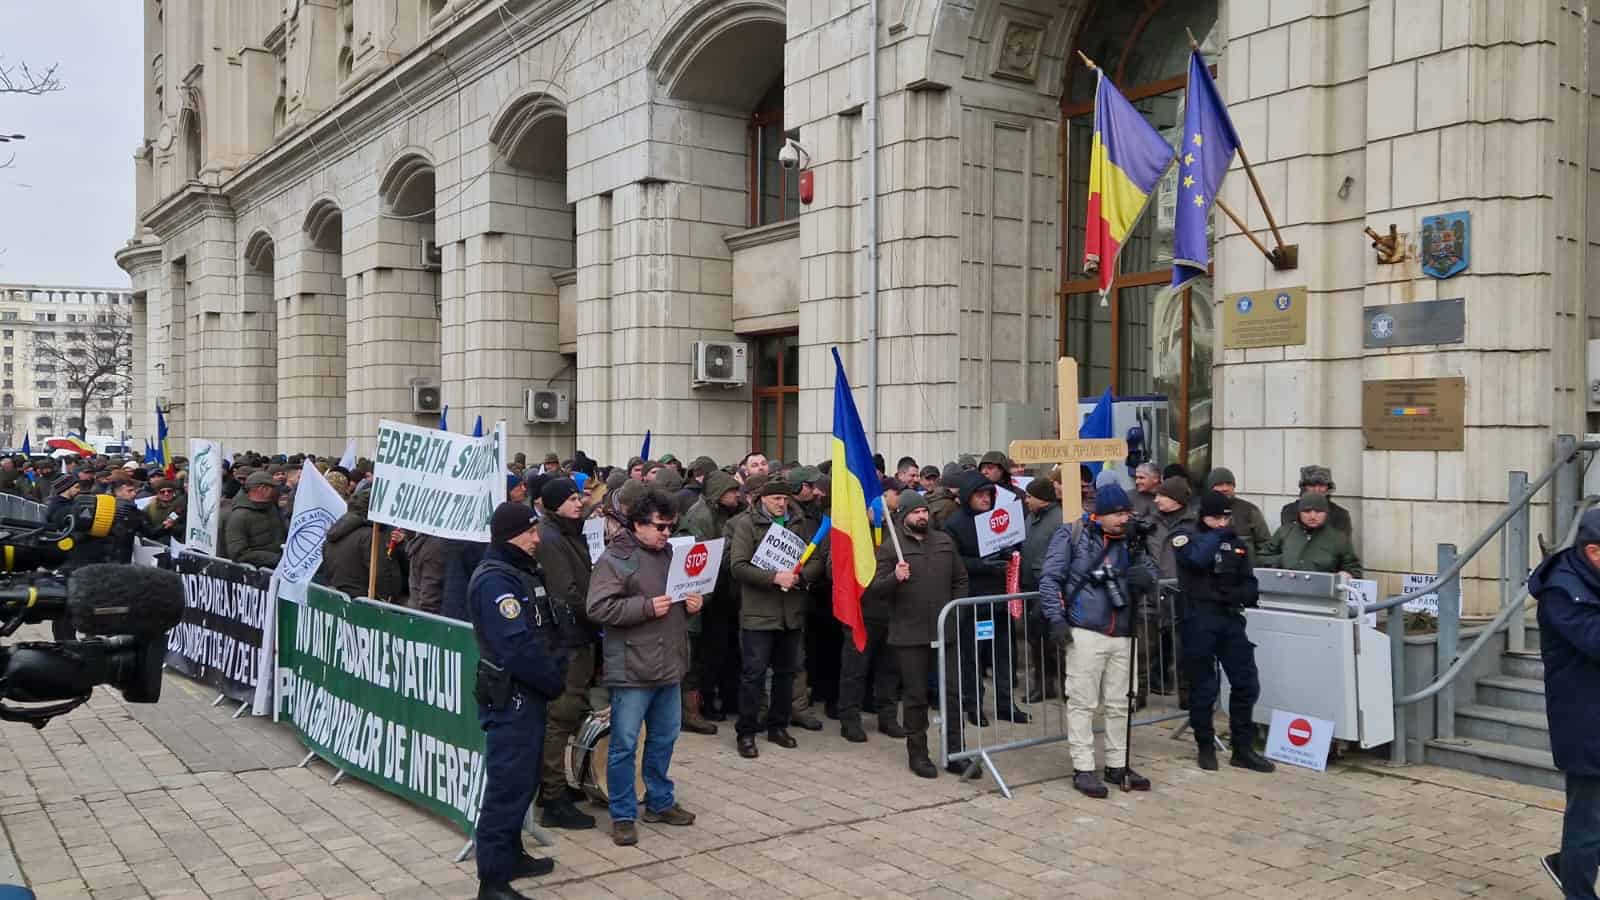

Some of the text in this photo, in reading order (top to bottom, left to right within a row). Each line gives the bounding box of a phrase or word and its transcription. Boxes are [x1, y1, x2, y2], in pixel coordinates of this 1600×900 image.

[991, 514, 1009, 529] STOP
[686, 552, 707, 569] STOP
[296, 606, 312, 655] NU
[392, 636, 463, 715] STATULUI
[384, 720, 406, 785] DE
